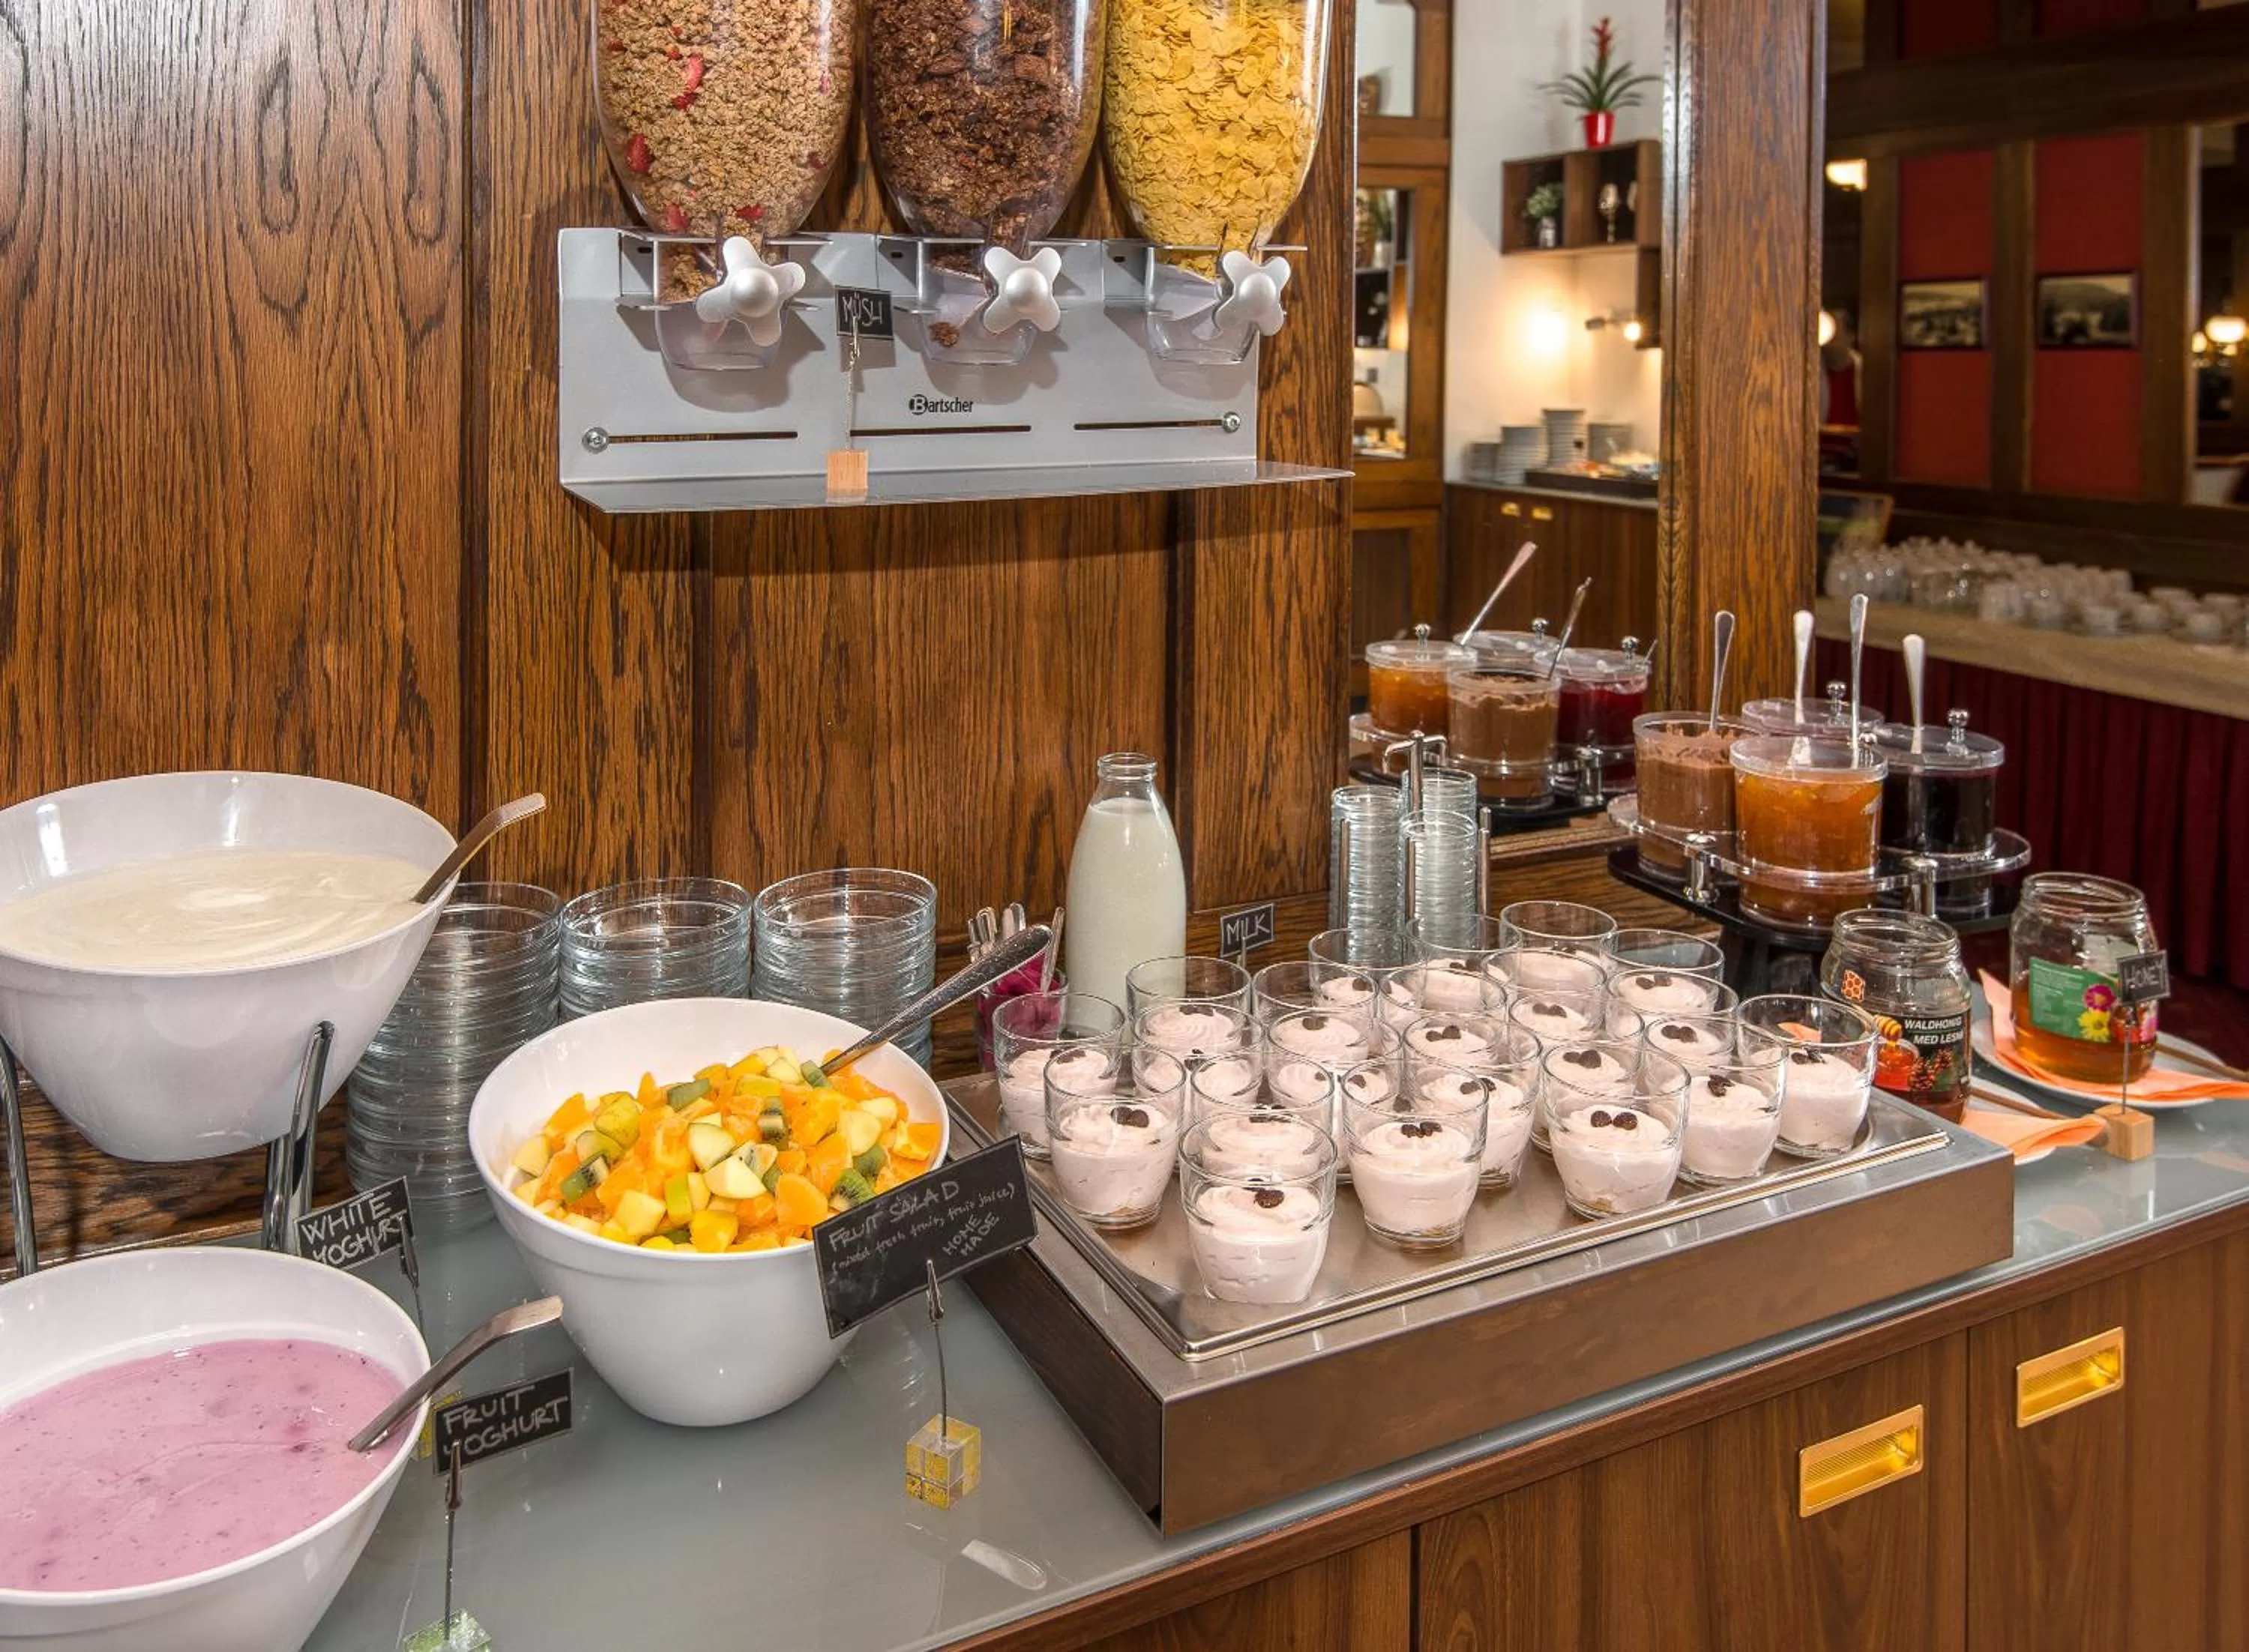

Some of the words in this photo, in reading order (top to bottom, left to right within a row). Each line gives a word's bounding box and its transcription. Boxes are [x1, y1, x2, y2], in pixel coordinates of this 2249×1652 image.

[909, 394, 973, 414] Bartscher
[1226, 913, 1270, 945] MILK
[2124, 958, 2164, 995] HONEY
[1913, 1034, 1939, 1044] MED
[301, 1191, 392, 1245] WHITE
[828, 1210, 884, 1252] FRUIT
[889, 1181, 960, 1223] SALAD
[942, 1214, 981, 1255] HOME
[960, 1211, 999, 1256] MADE
[444, 1385, 535, 1434] FRUIT
